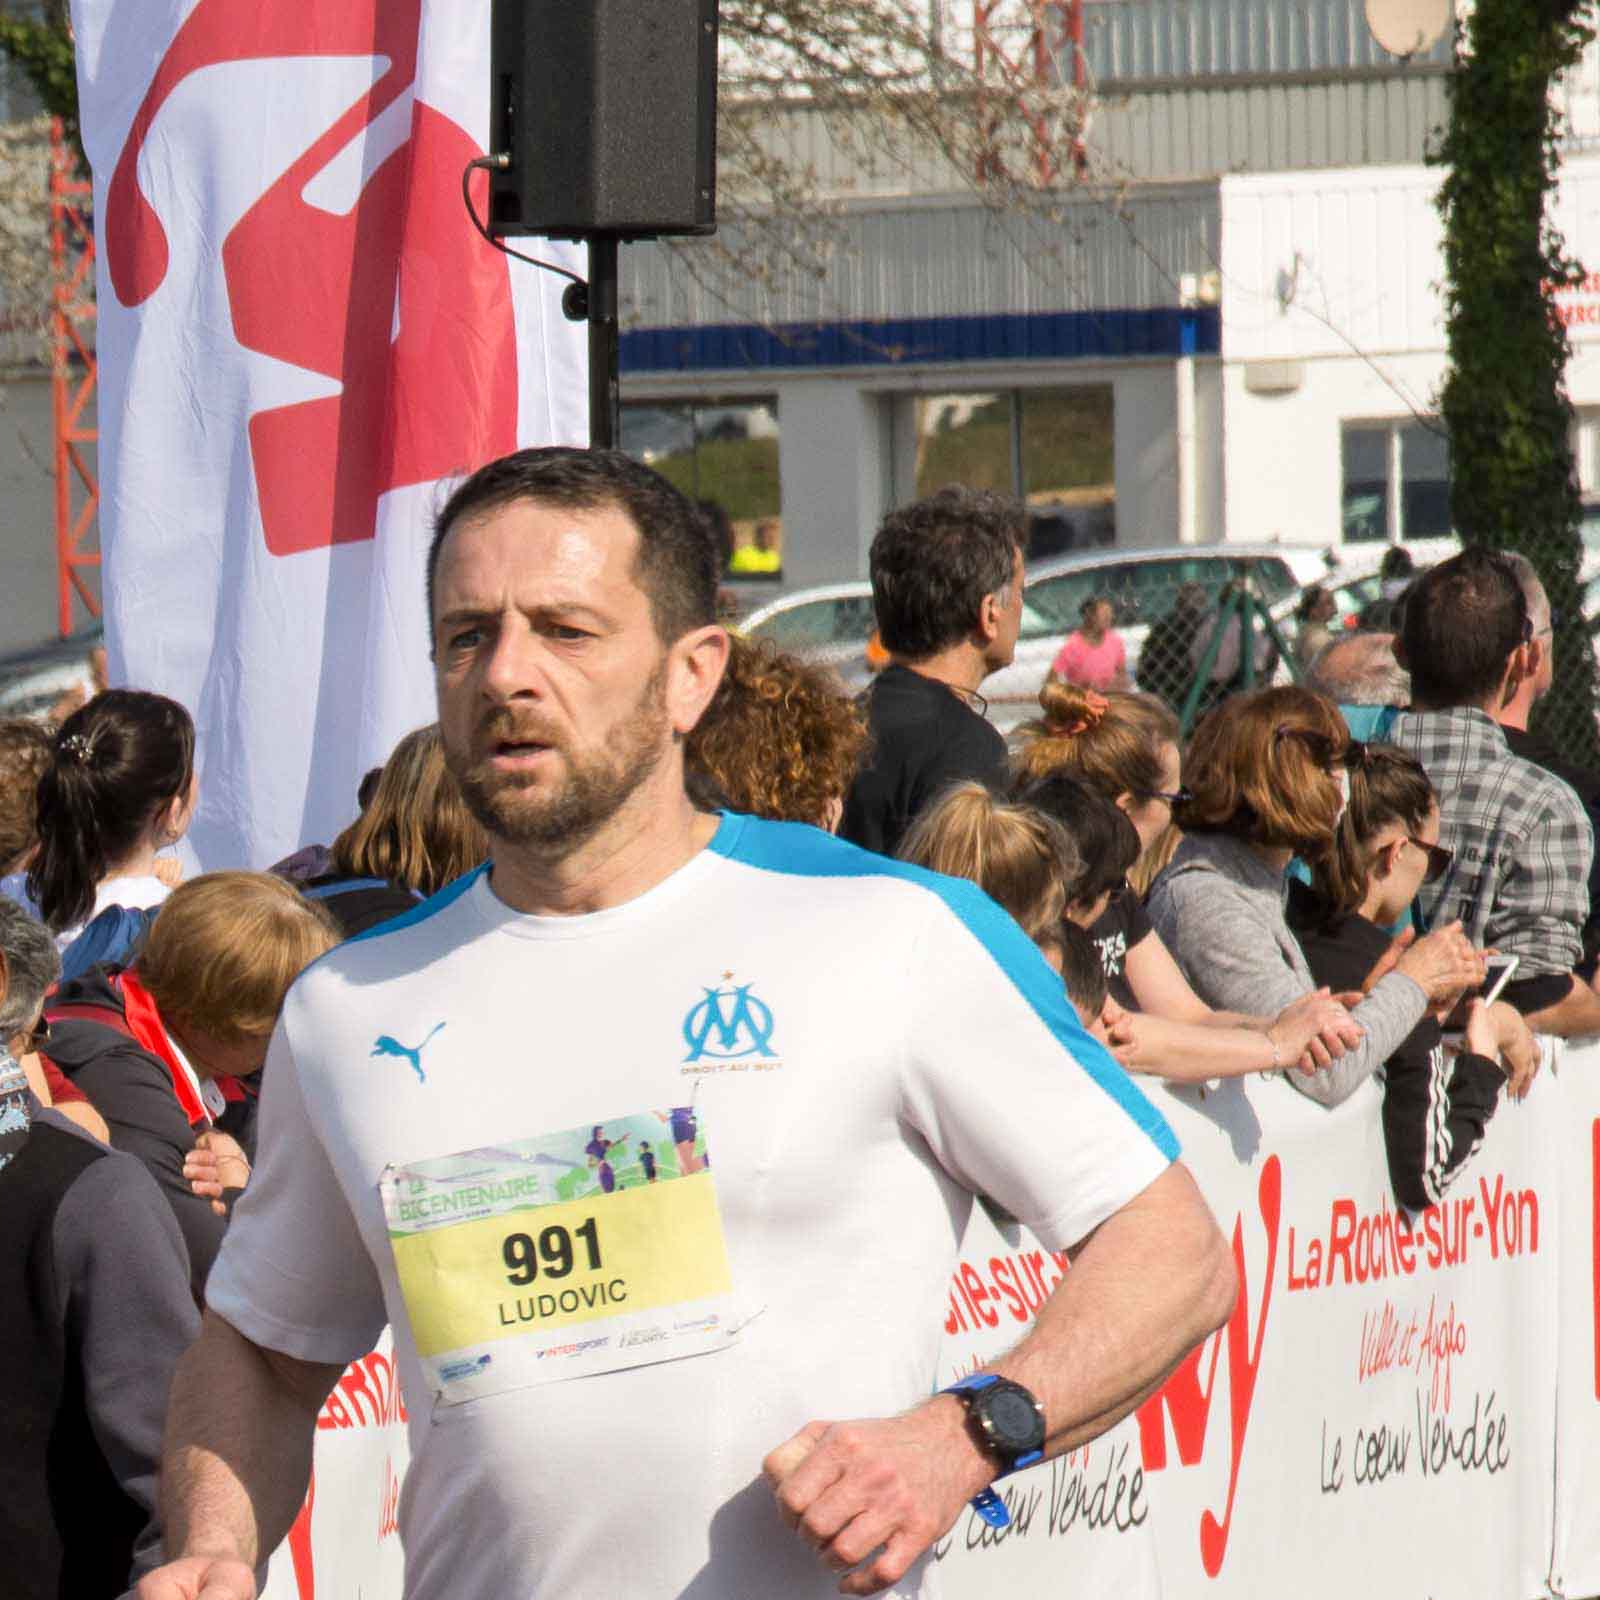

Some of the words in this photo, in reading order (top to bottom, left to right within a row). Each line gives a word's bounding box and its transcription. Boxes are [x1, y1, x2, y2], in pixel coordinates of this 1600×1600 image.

[502, 1217, 602, 1286] 991
[1325, 1173, 1539, 1288] Roche-sur-Yon
[499, 1279, 628, 1326] LUDOVIC
[1415, 1291, 1467, 1414] Agglo
[1320, 1417, 1345, 1495] Le
[1415, 1386, 1511, 1479] Vendée
